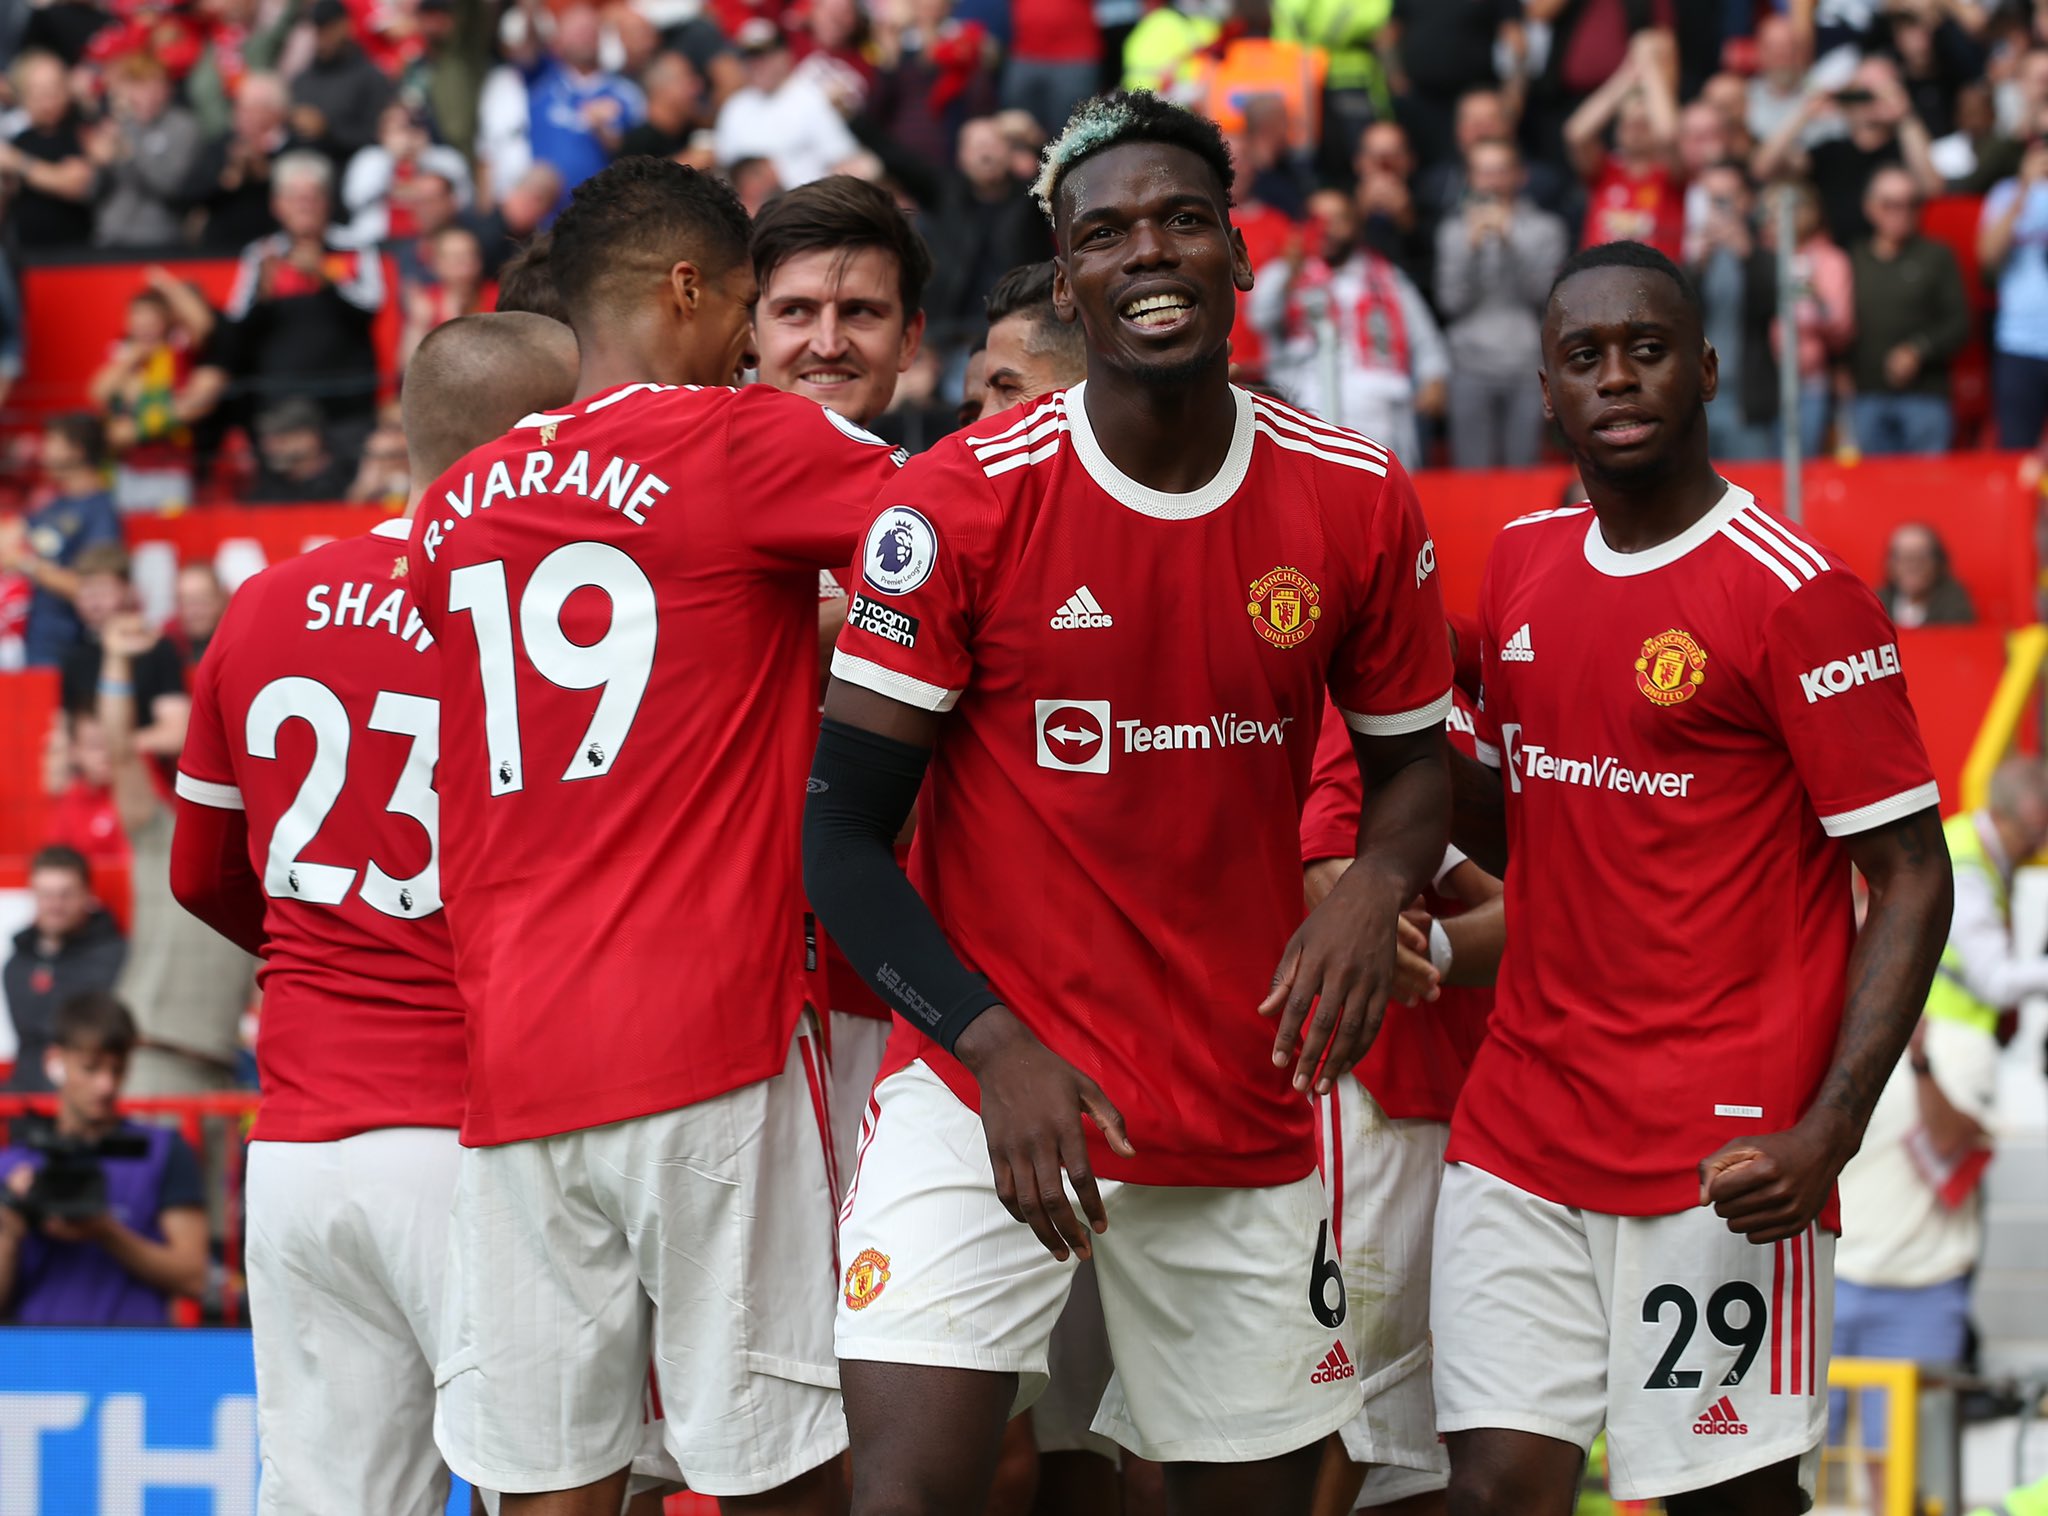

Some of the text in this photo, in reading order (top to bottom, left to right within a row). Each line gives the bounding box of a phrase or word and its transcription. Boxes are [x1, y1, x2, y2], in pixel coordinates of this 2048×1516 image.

[423, 449, 672, 562] R.VARANE
[880, 559, 923, 586] Premier League
[1255, 572, 1315, 601] MANCHESTER
[859, 614, 915, 648] racism
[865, 601, 911, 632] room
[1050, 612, 1113, 630] adidas
[1264, 628, 1305, 643] UNITED
[448, 540, 659, 798] 19
[1799, 643, 1901, 704] KOHLE
[245, 675, 444, 920] 23
[1309, 1218, 1347, 1329] 6
[1642, 1280, 1768, 1389] 29
[1310, 1363, 1355, 1385] adidas
[1692, 1419, 1749, 1435] adidas
